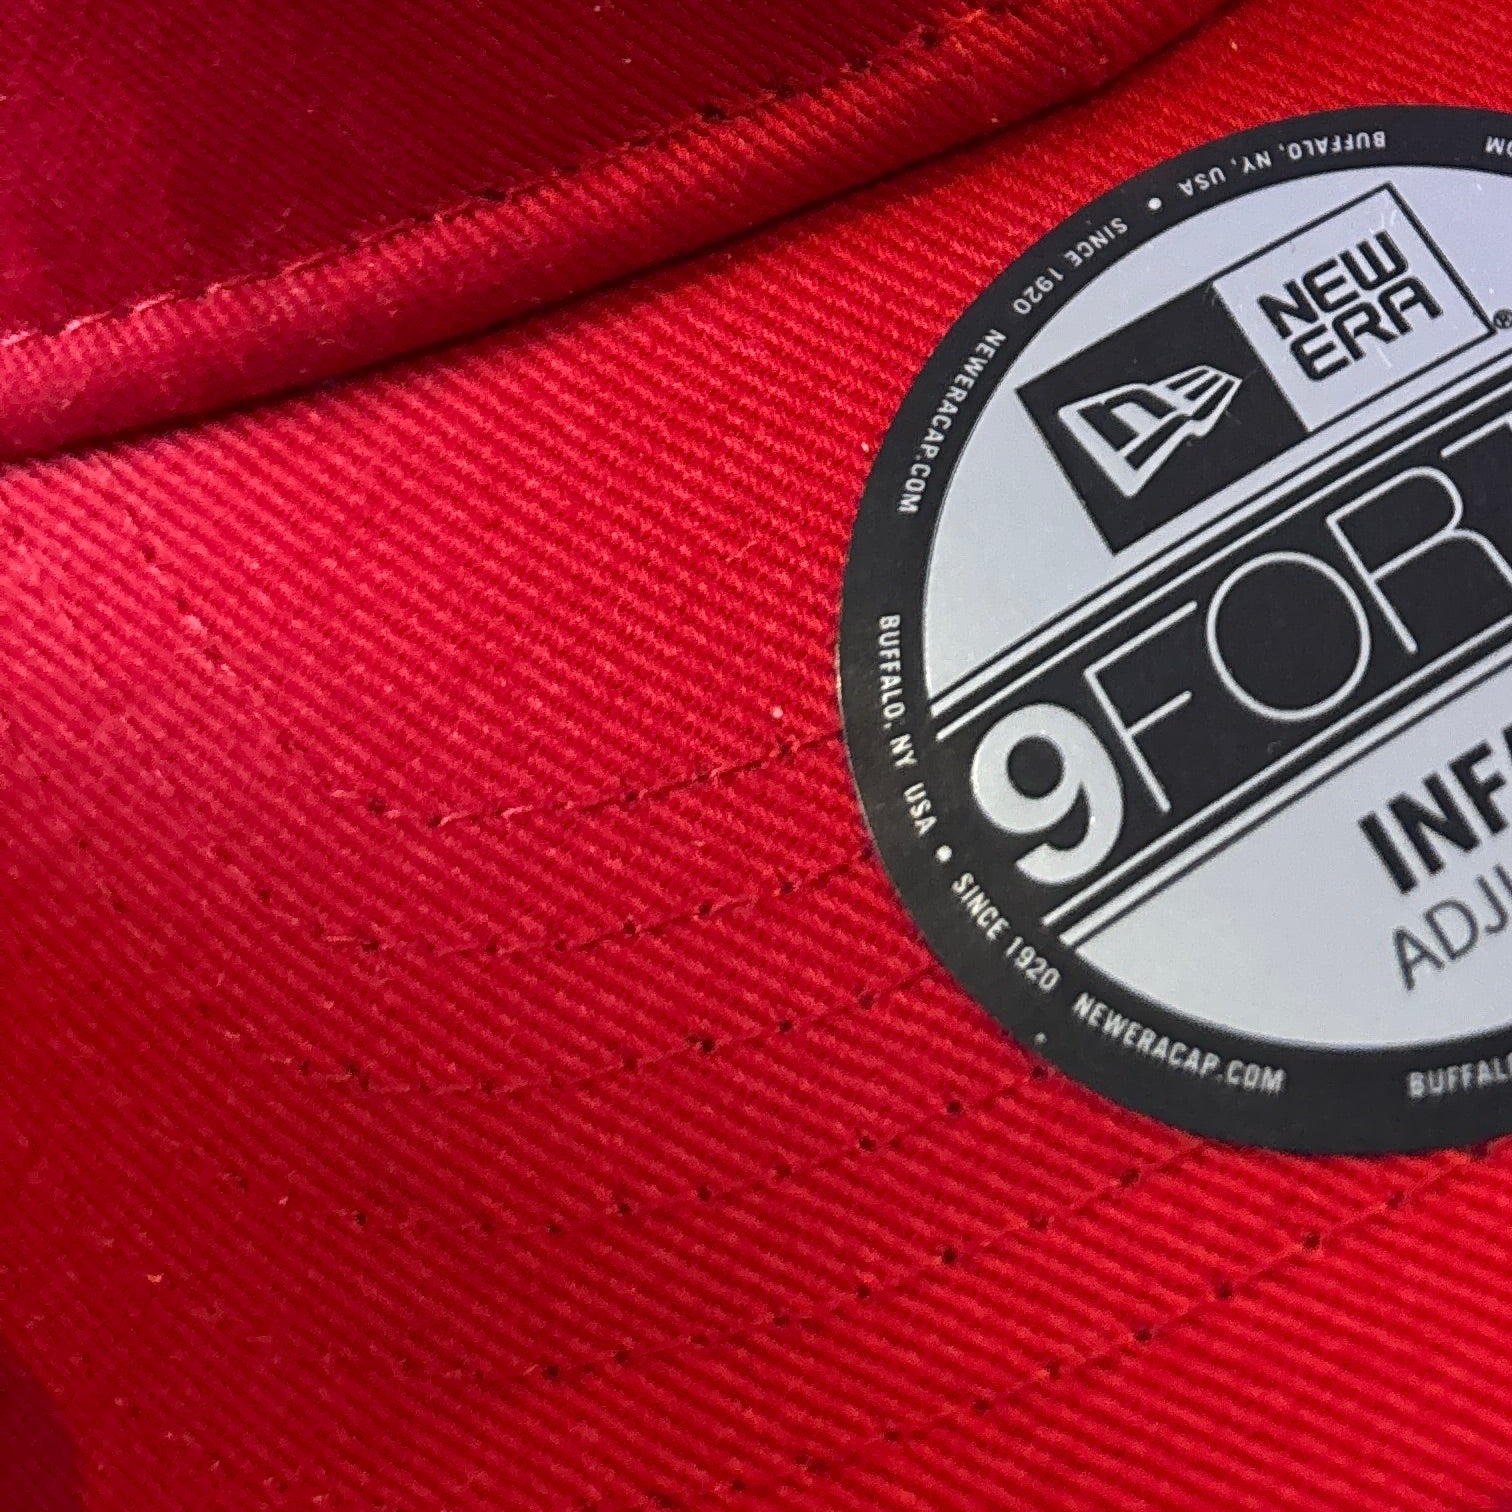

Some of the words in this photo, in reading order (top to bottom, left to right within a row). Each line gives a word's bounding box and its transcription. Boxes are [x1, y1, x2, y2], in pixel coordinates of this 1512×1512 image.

[1178, 167, 1226, 196] USA
[1278, 130, 1386, 161] BUFFALO,
[1063, 217, 1128, 268] SINCE
[1012, 267, 1064, 315] 1920
[1256, 229, 1409, 339] NEW
[1289, 275, 1443, 382] ERA
[898, 328, 1007, 515] NEWERACAP.COM
[877, 614, 905, 730] BUFFALO,
[903, 782, 938, 838] USA
[951, 872, 1010, 942] SINCE
[1005, 936, 1061, 993] 1920
[1072, 992, 1286, 1095] NEWERACAP.COM
